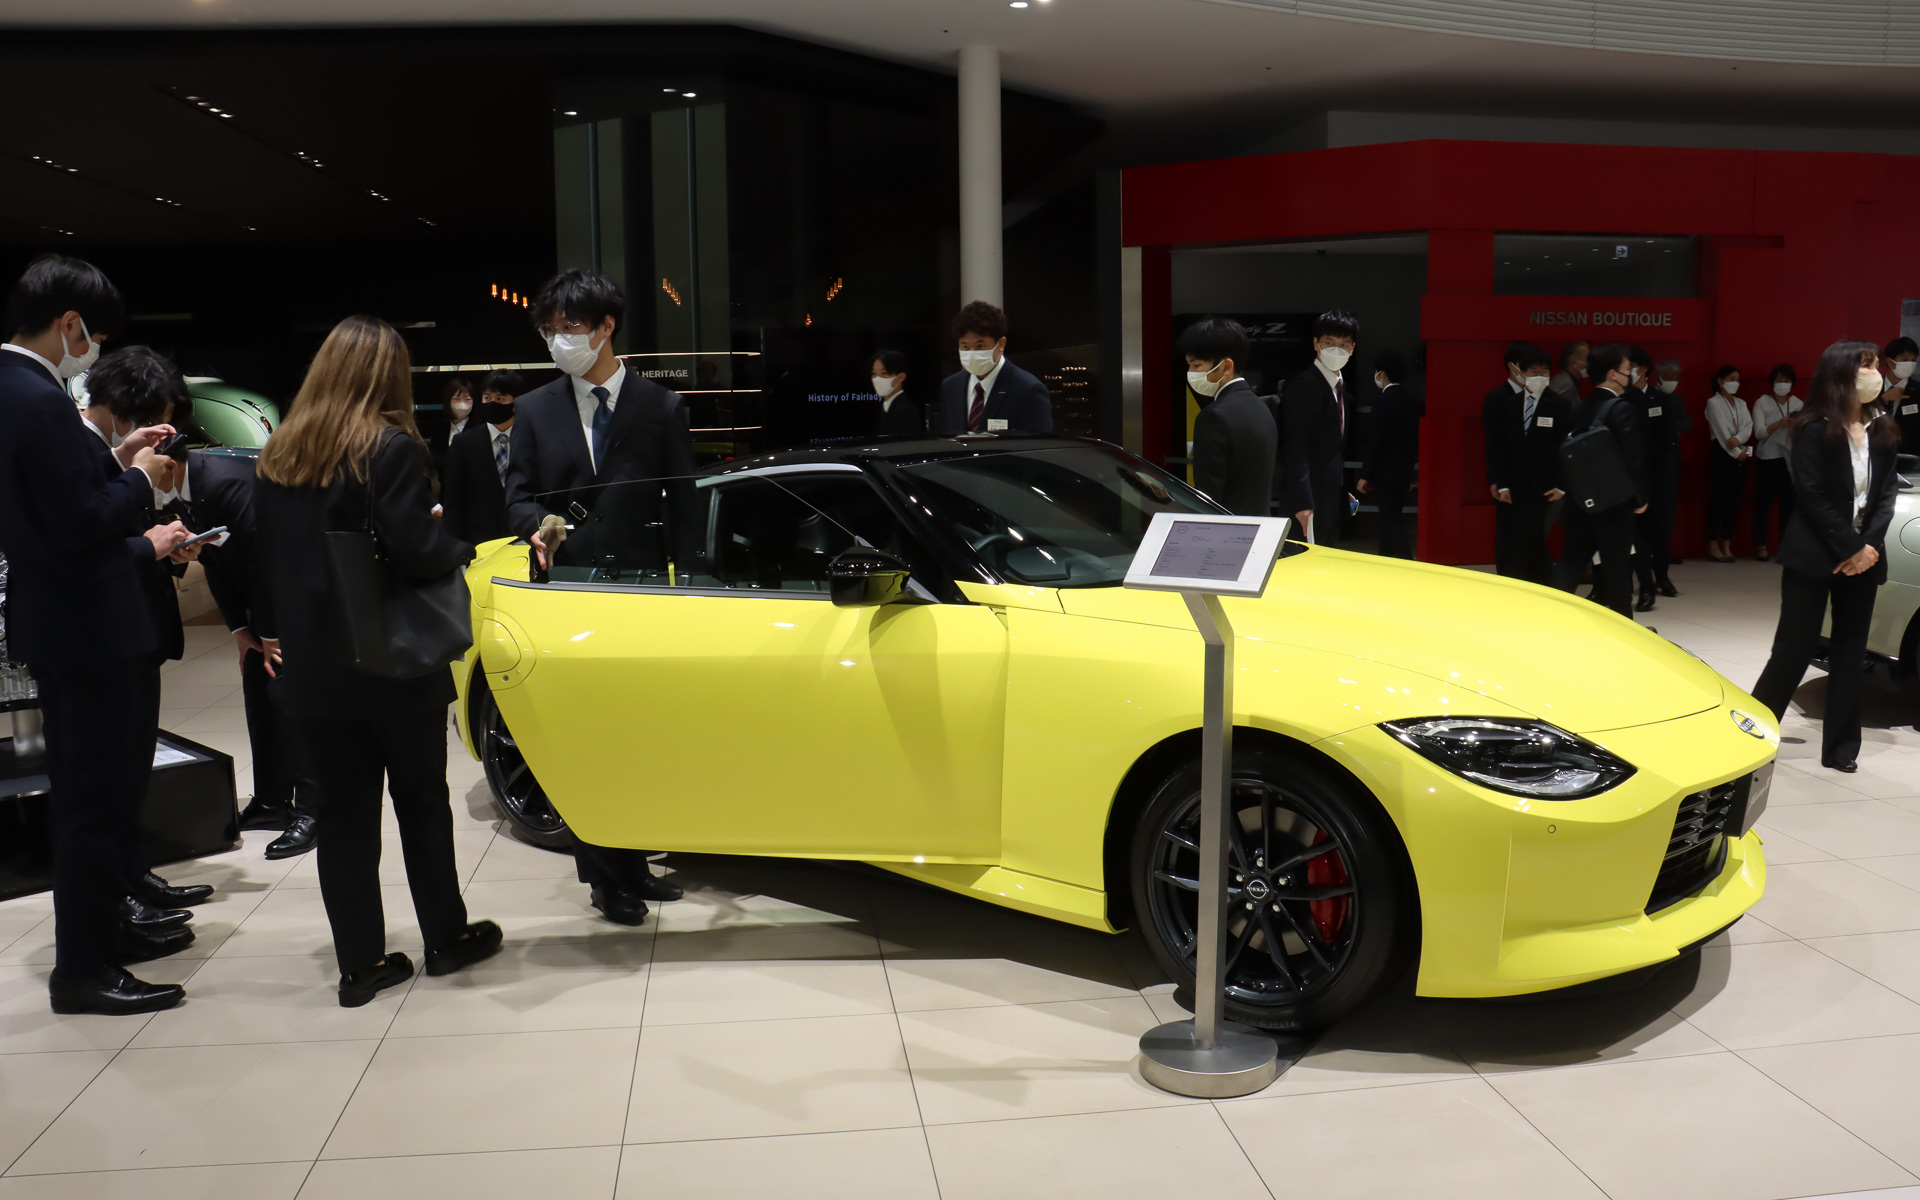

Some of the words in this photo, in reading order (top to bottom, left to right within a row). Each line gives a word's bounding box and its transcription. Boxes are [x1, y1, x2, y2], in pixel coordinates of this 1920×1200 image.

[1530, 311, 1587, 325] NISSAN
[1592, 312, 1672, 326] BOUTIQUE
[641, 369, 689, 378] HERITAGE
[808, 393, 838, 403] History
[841, 392, 850, 402] of
